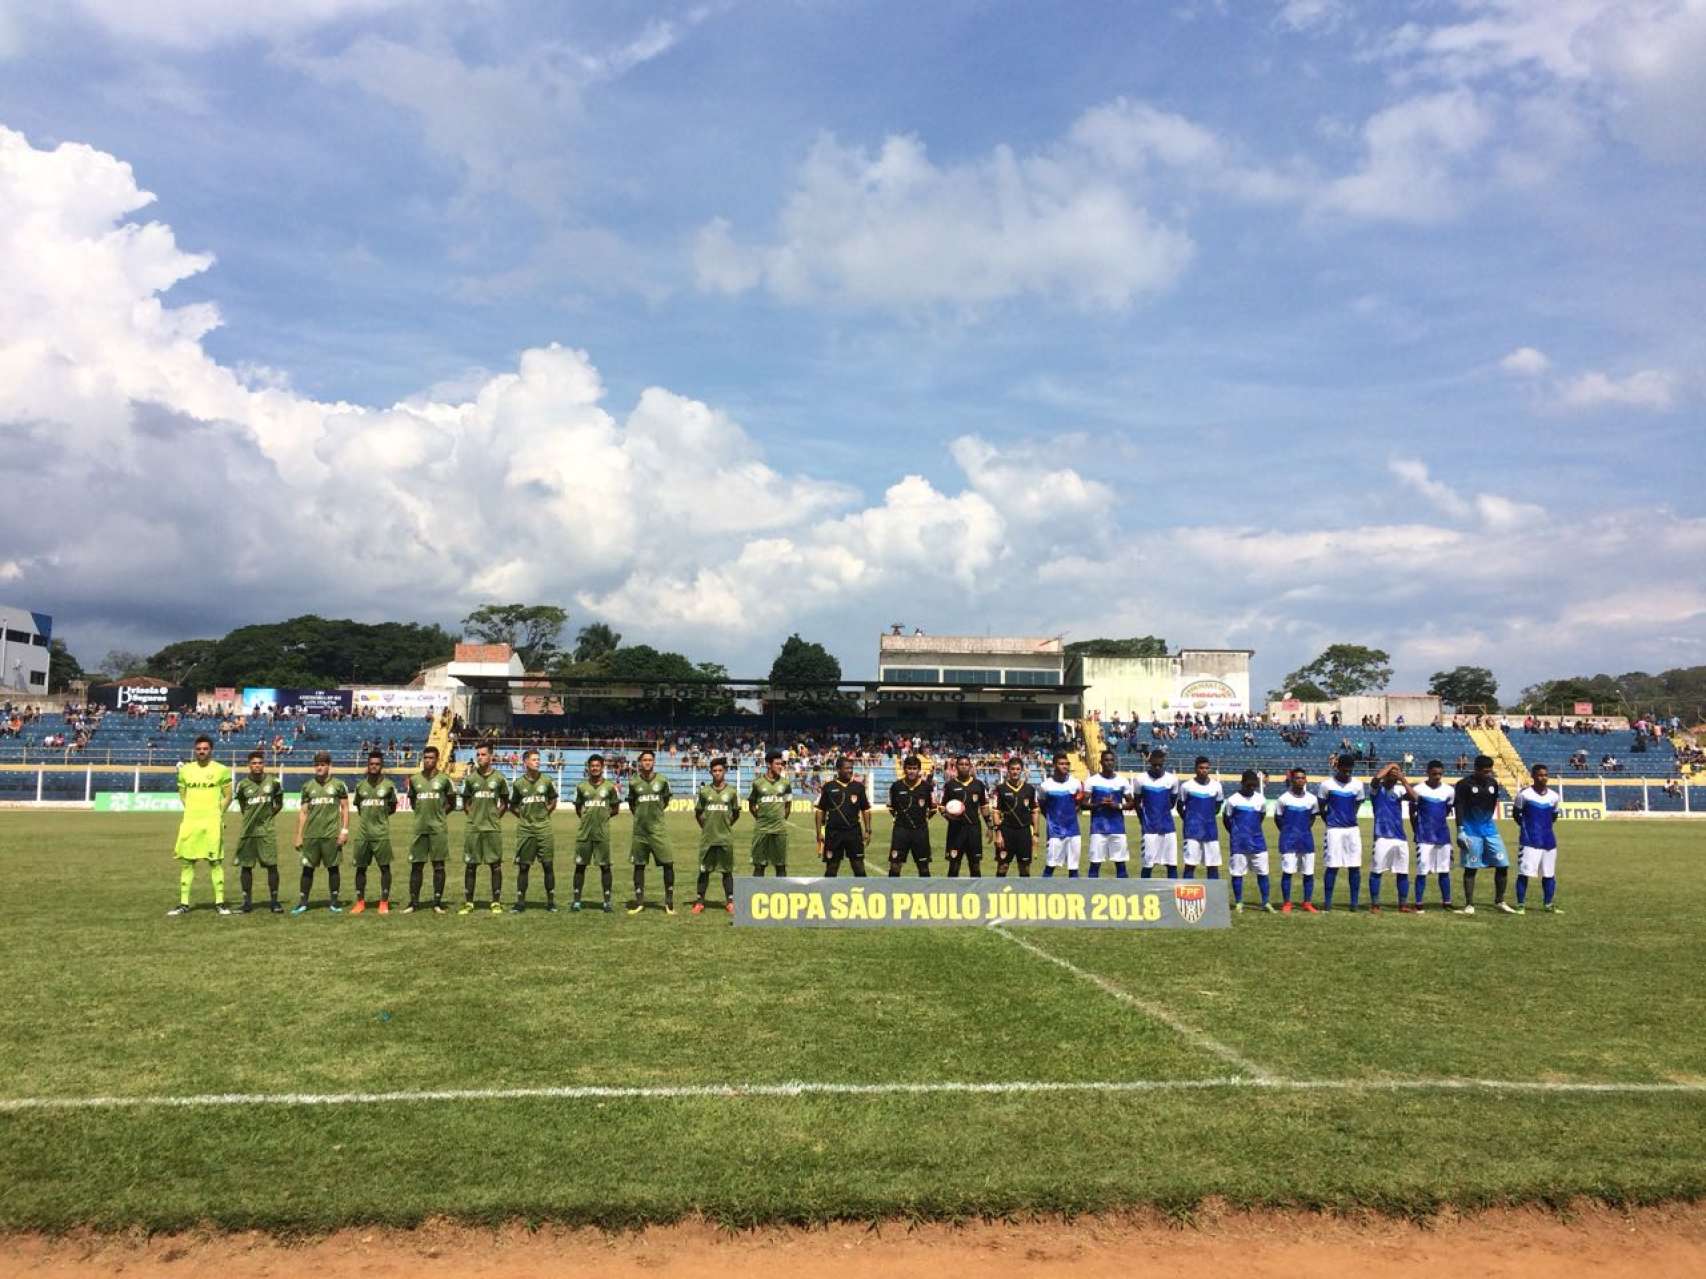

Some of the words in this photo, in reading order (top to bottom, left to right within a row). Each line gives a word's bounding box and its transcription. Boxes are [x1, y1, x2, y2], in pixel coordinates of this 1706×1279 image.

[751, 892, 826, 920] COPA
[830, 886, 887, 920] SÃO
[892, 892, 980, 920] PAULO
[985, 885, 1087, 921] JÚNIOR
[1091, 893, 1162, 922] 2018
